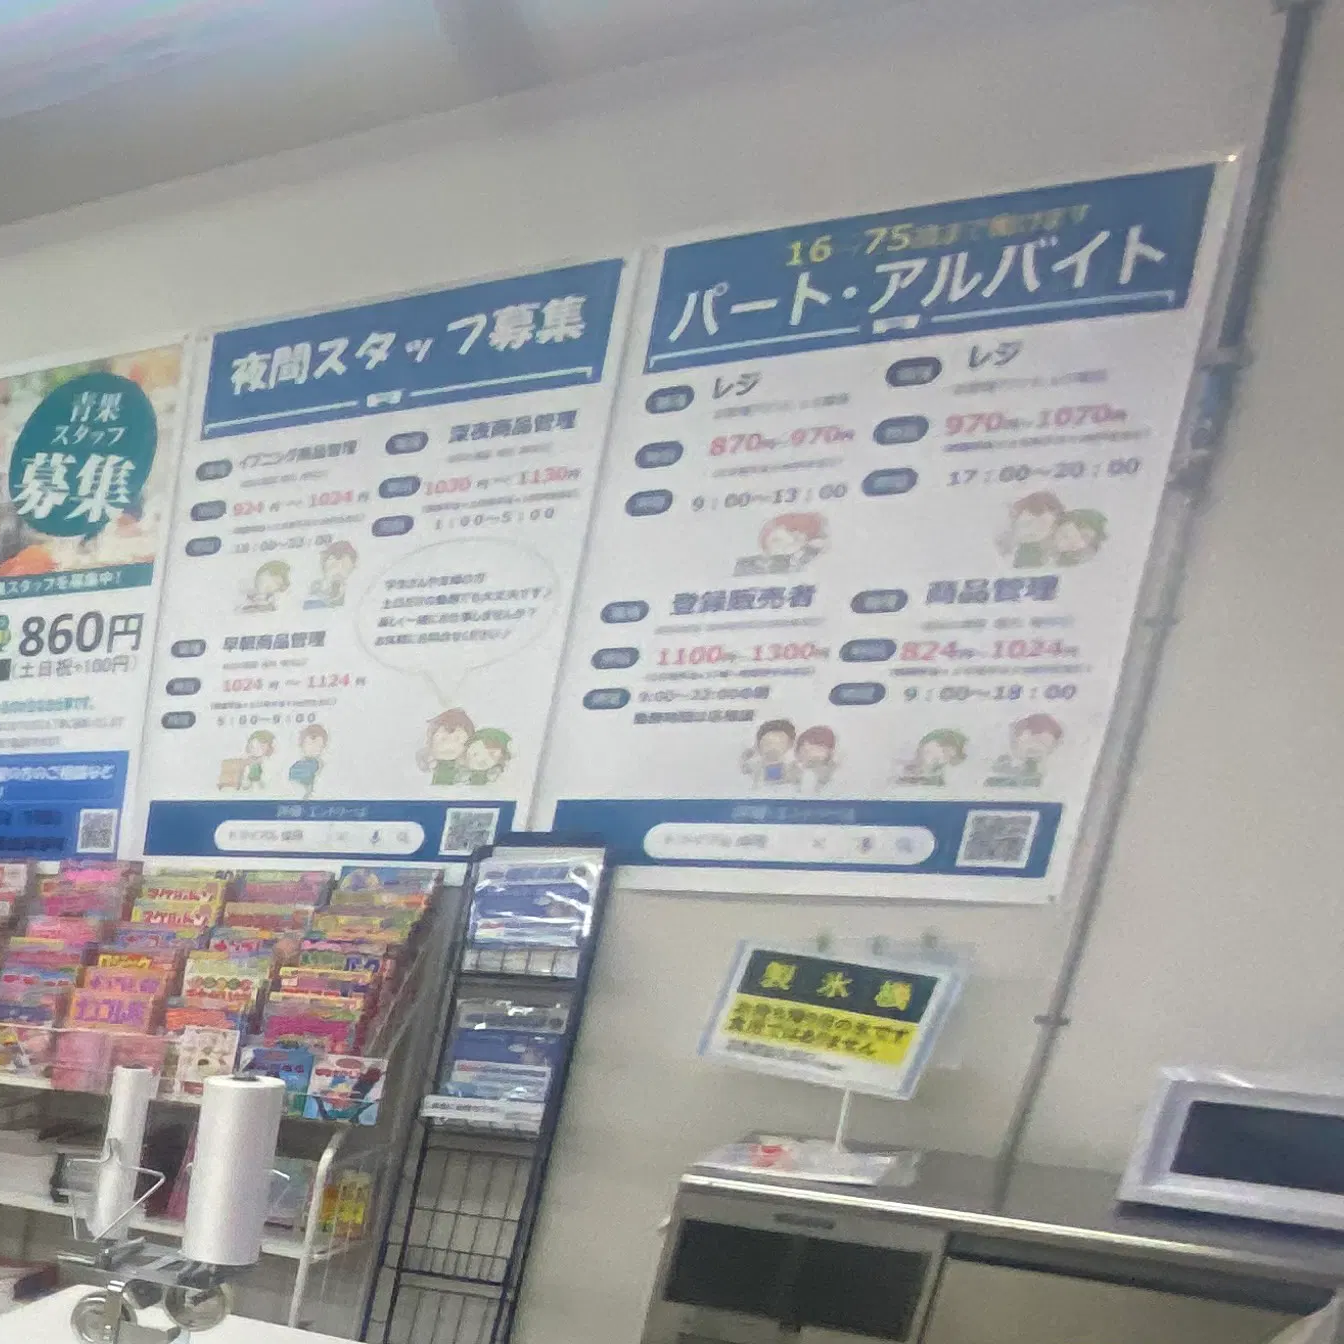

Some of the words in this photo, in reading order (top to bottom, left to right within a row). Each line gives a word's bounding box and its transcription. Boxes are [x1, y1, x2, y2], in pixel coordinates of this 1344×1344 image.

[668, 224, 1167, 342] パート・アルバイト
[231, 293, 587, 396] 夜間スタッフ募集
[968, 341, 1022, 369] レジ
[713, 372, 761, 399] レジ
[70, 391, 123, 422] 青果
[51, 424, 127, 447] スタッフ
[11, 452, 136, 523] 募集
[19, 610, 145, 657] 860円
